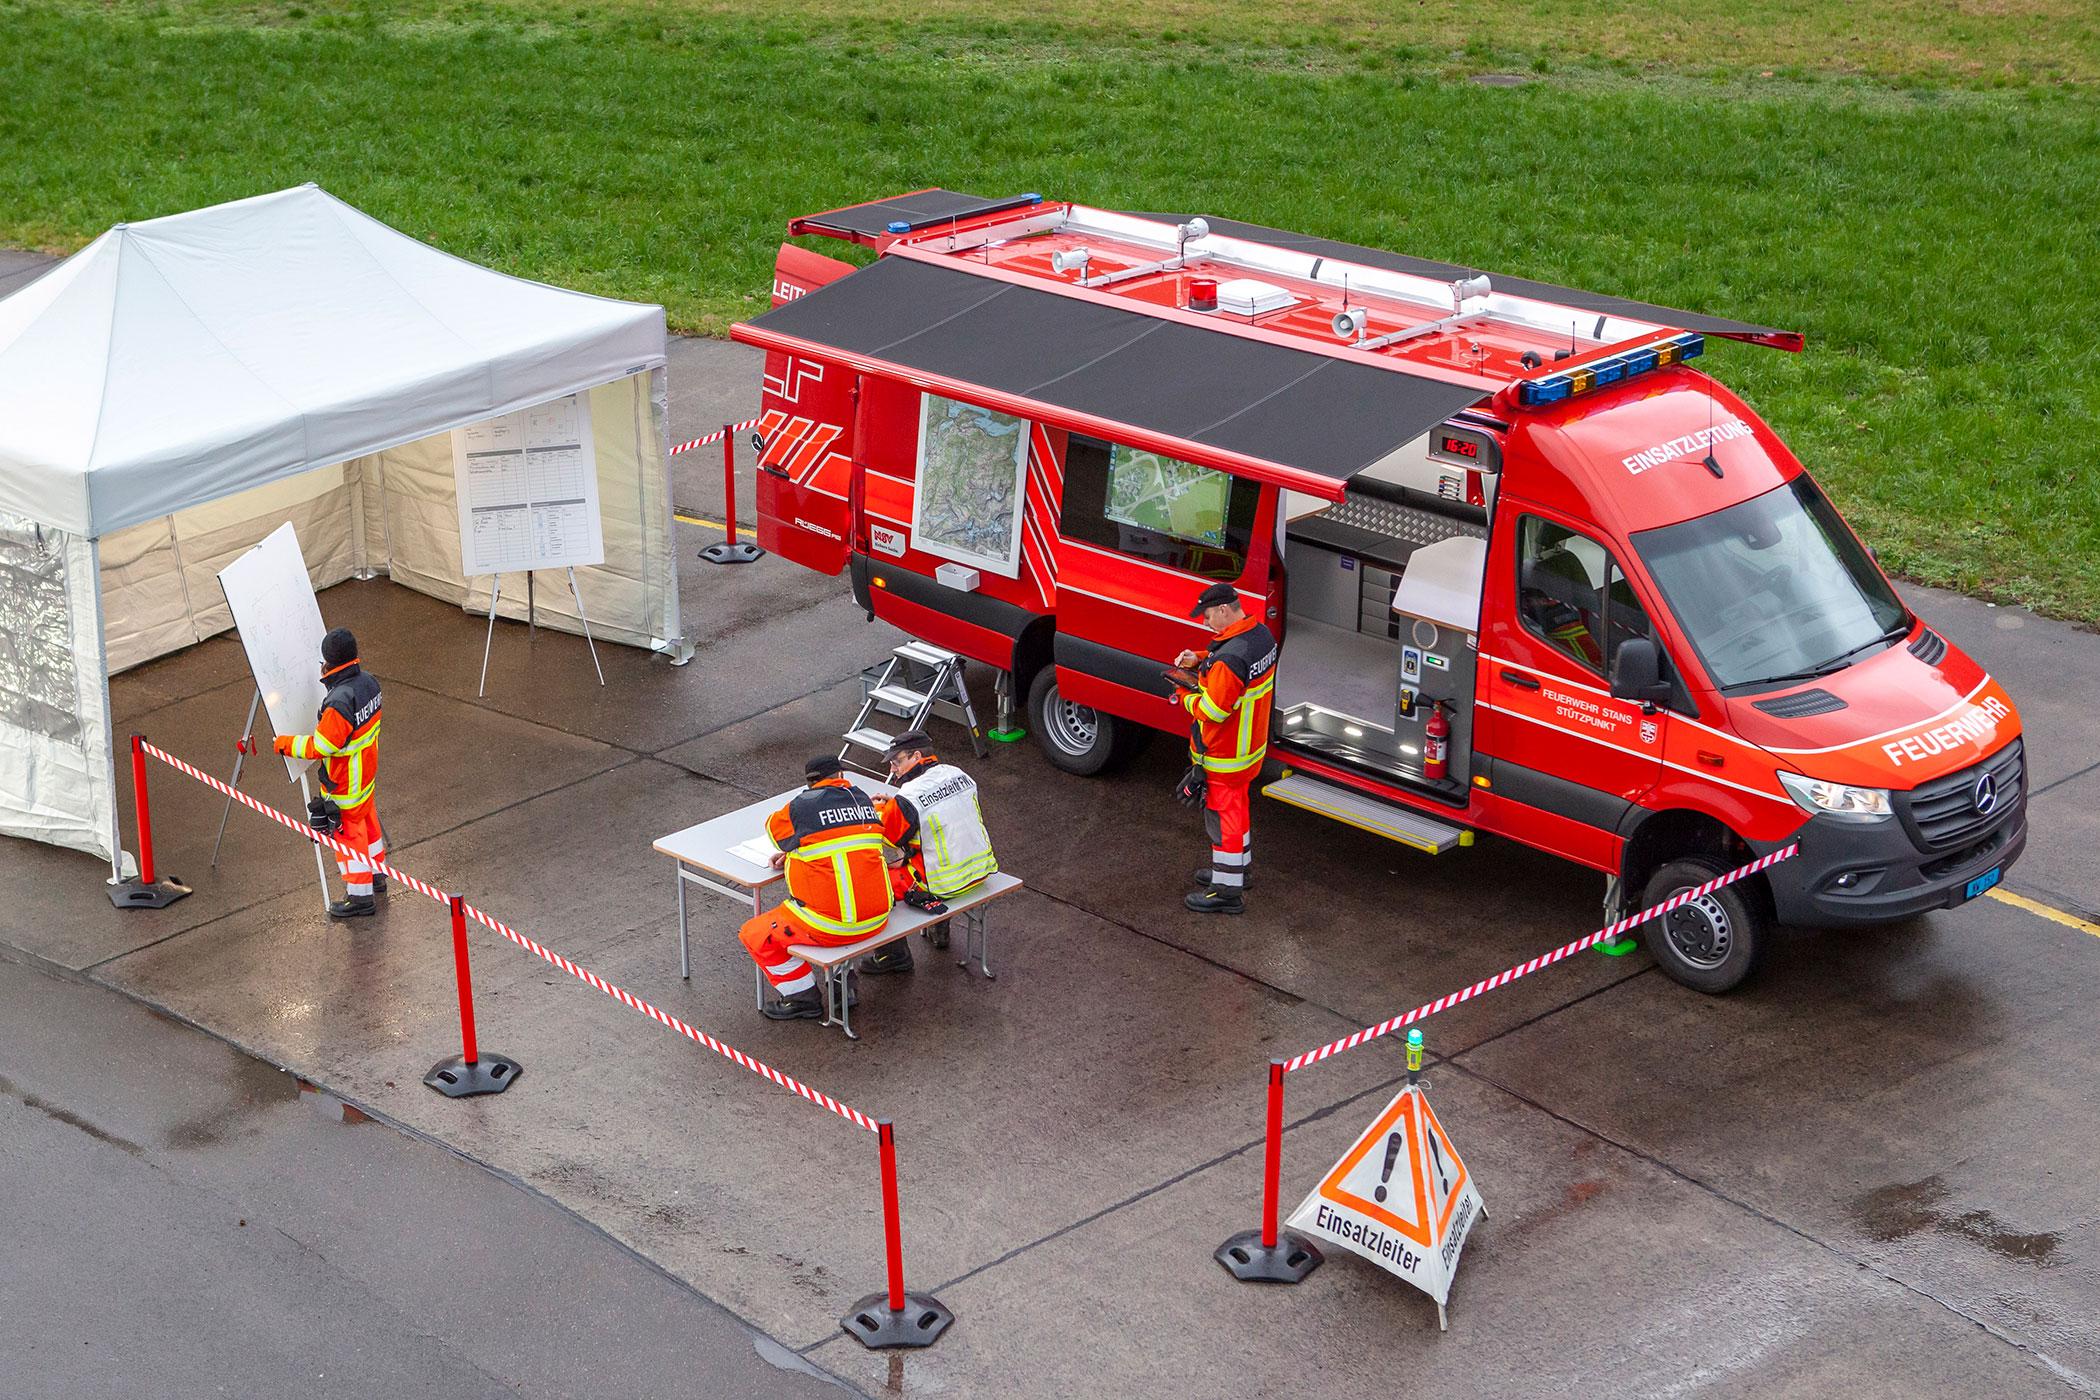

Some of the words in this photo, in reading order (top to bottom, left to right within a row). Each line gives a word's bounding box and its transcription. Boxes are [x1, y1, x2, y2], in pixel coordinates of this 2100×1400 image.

[773, 279, 806, 301] LEIT
[1446, 439, 1478, 457] 16:20
[1622, 419, 1754, 475] EINSATZLEITUNG
[1542, 688, 1600, 714] FEUERWEHR
[1602, 707, 1633, 725] STANS
[1556, 706, 1617, 732] STÜTZPUNKT
[1881, 696, 2010, 767] FEUERWEHR
[818, 806, 878, 826] FEUERWEH
[1316, 1204, 1422, 1275] Einsatzleiter
[1441, 1194, 1475, 1272] Einsatzleiter
